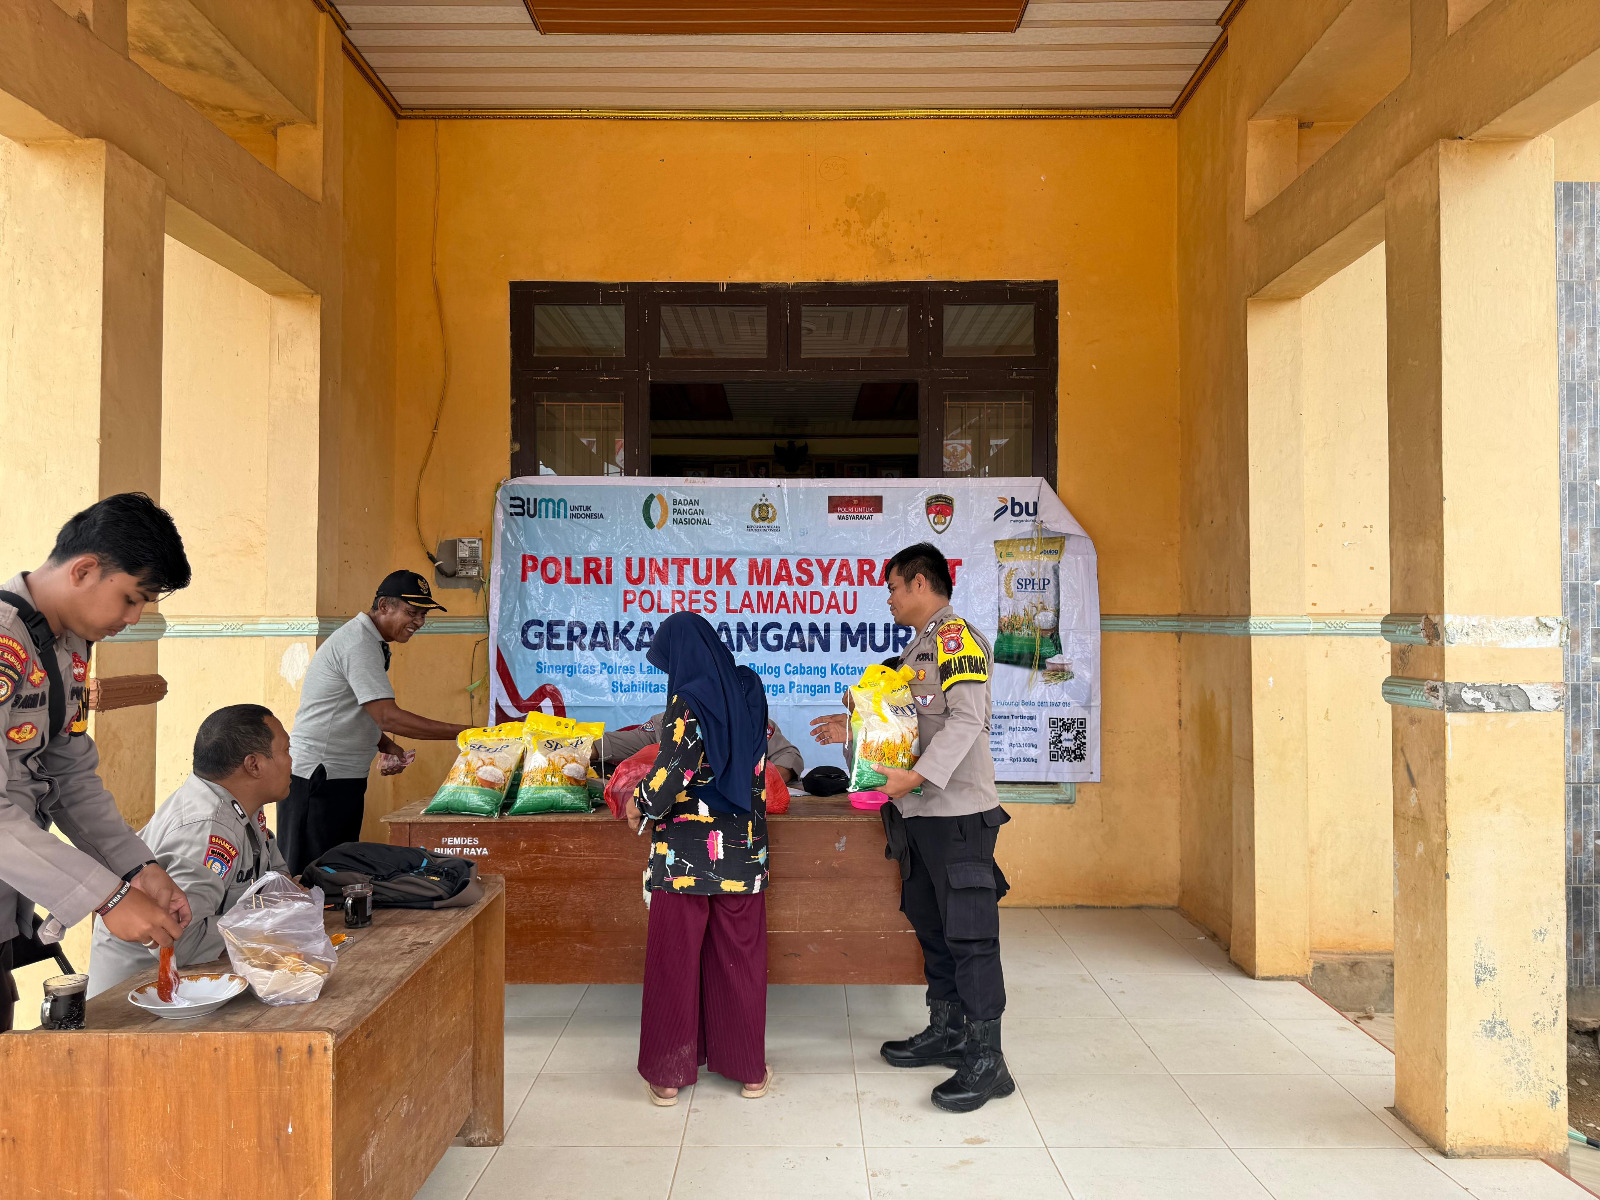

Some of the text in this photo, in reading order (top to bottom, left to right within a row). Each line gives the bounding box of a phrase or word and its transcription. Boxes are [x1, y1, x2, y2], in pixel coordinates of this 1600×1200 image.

[672, 508, 705, 516] PANGAN
[1010, 496, 1039, 517] bu
[521, 554, 613, 585] POLRI
[625, 556, 738, 586] UNTUK
[622, 590, 858, 615] POLRES LAMANDAU
[520, 619, 659, 651] GERAKA
[716, 621, 831, 652] ANGAN
[840, 622, 913, 652] MUR
[535, 661, 596, 677] Sinergitas
[599, 662, 636, 675] Polres
[749, 663, 780, 678] Bulog
[784, 663, 827, 678] Cabang
[830, 663, 867, 676] Kotaw
[611, 681, 667, 694] Stabilitas
[762, 683, 786, 697] arga
[788, 682, 831, 697] Pangan
[441, 837, 480, 845] PEMDES
[433, 847, 489, 856] BUKIT RAYA
